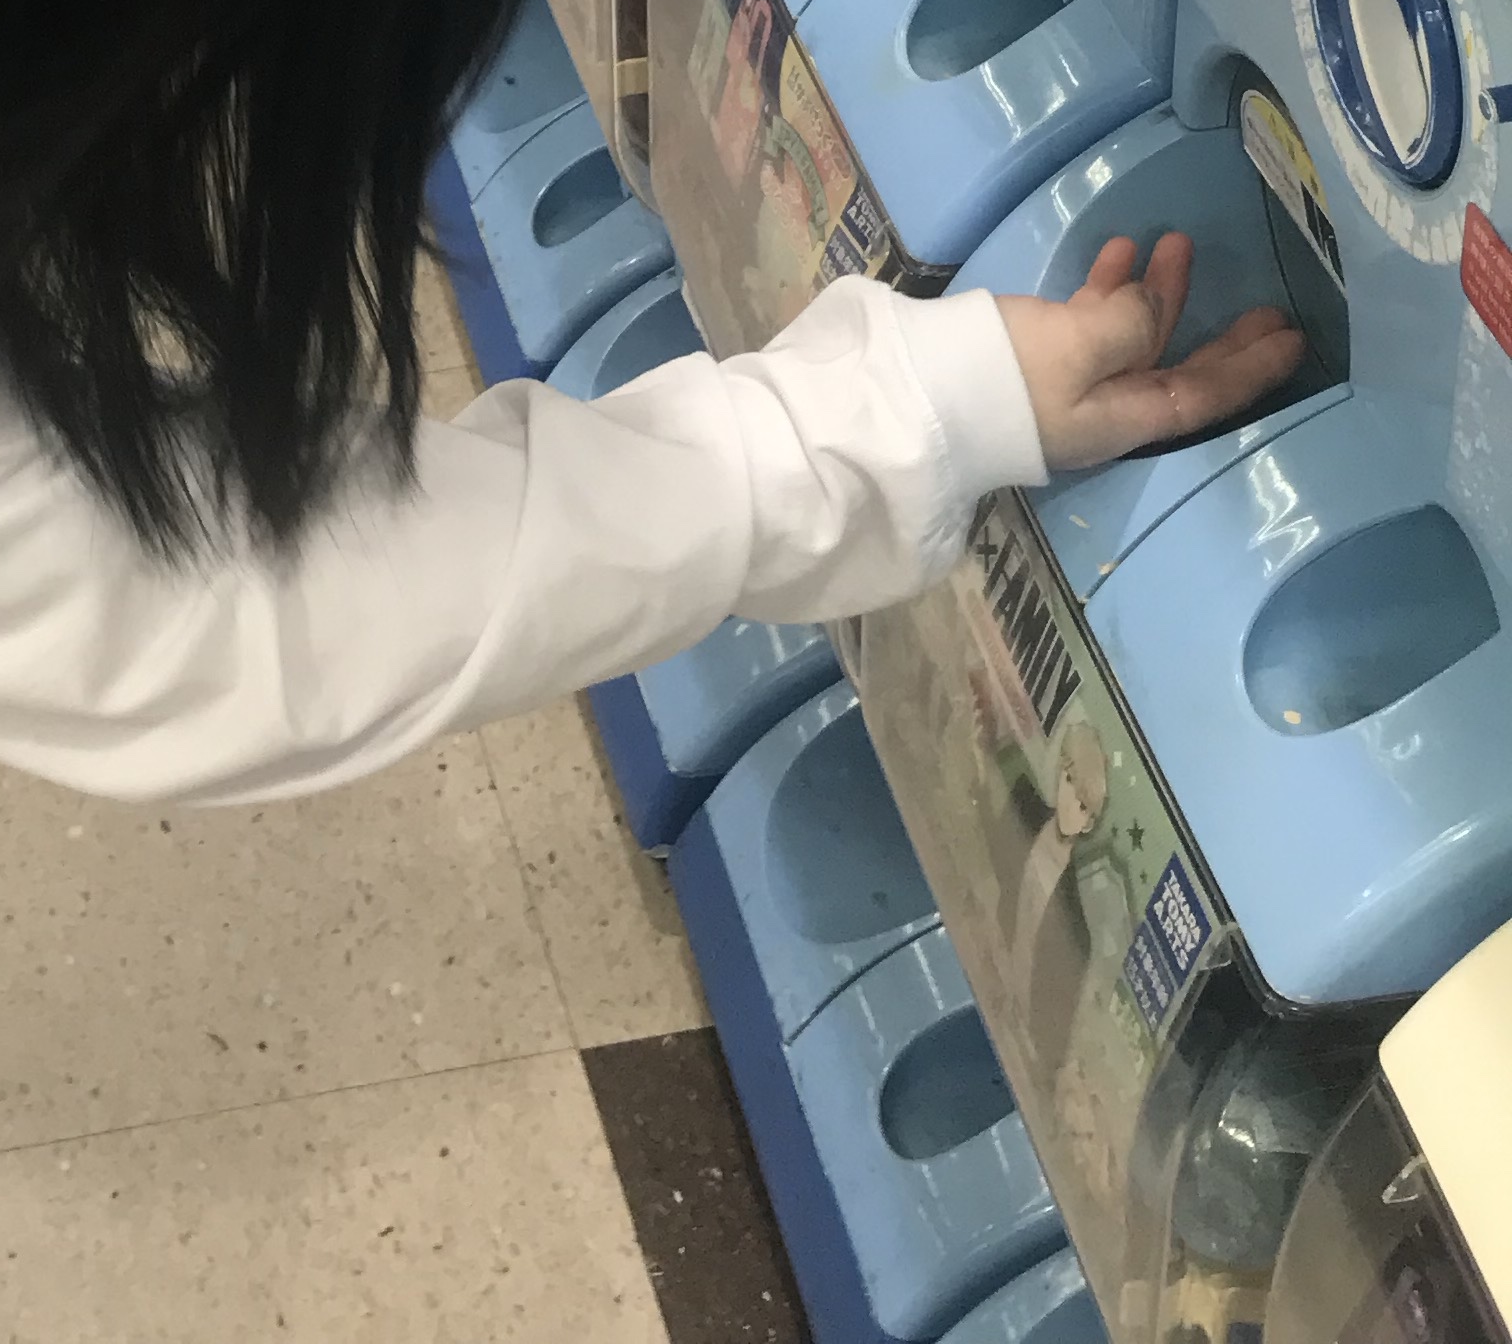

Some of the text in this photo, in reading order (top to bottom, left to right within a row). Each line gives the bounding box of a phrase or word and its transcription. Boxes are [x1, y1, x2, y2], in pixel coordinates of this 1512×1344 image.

[1153, 899, 1187, 971] ARTS
[1161, 881, 1196, 954] TOMY
[1168, 868, 1201, 945] TAKARA
